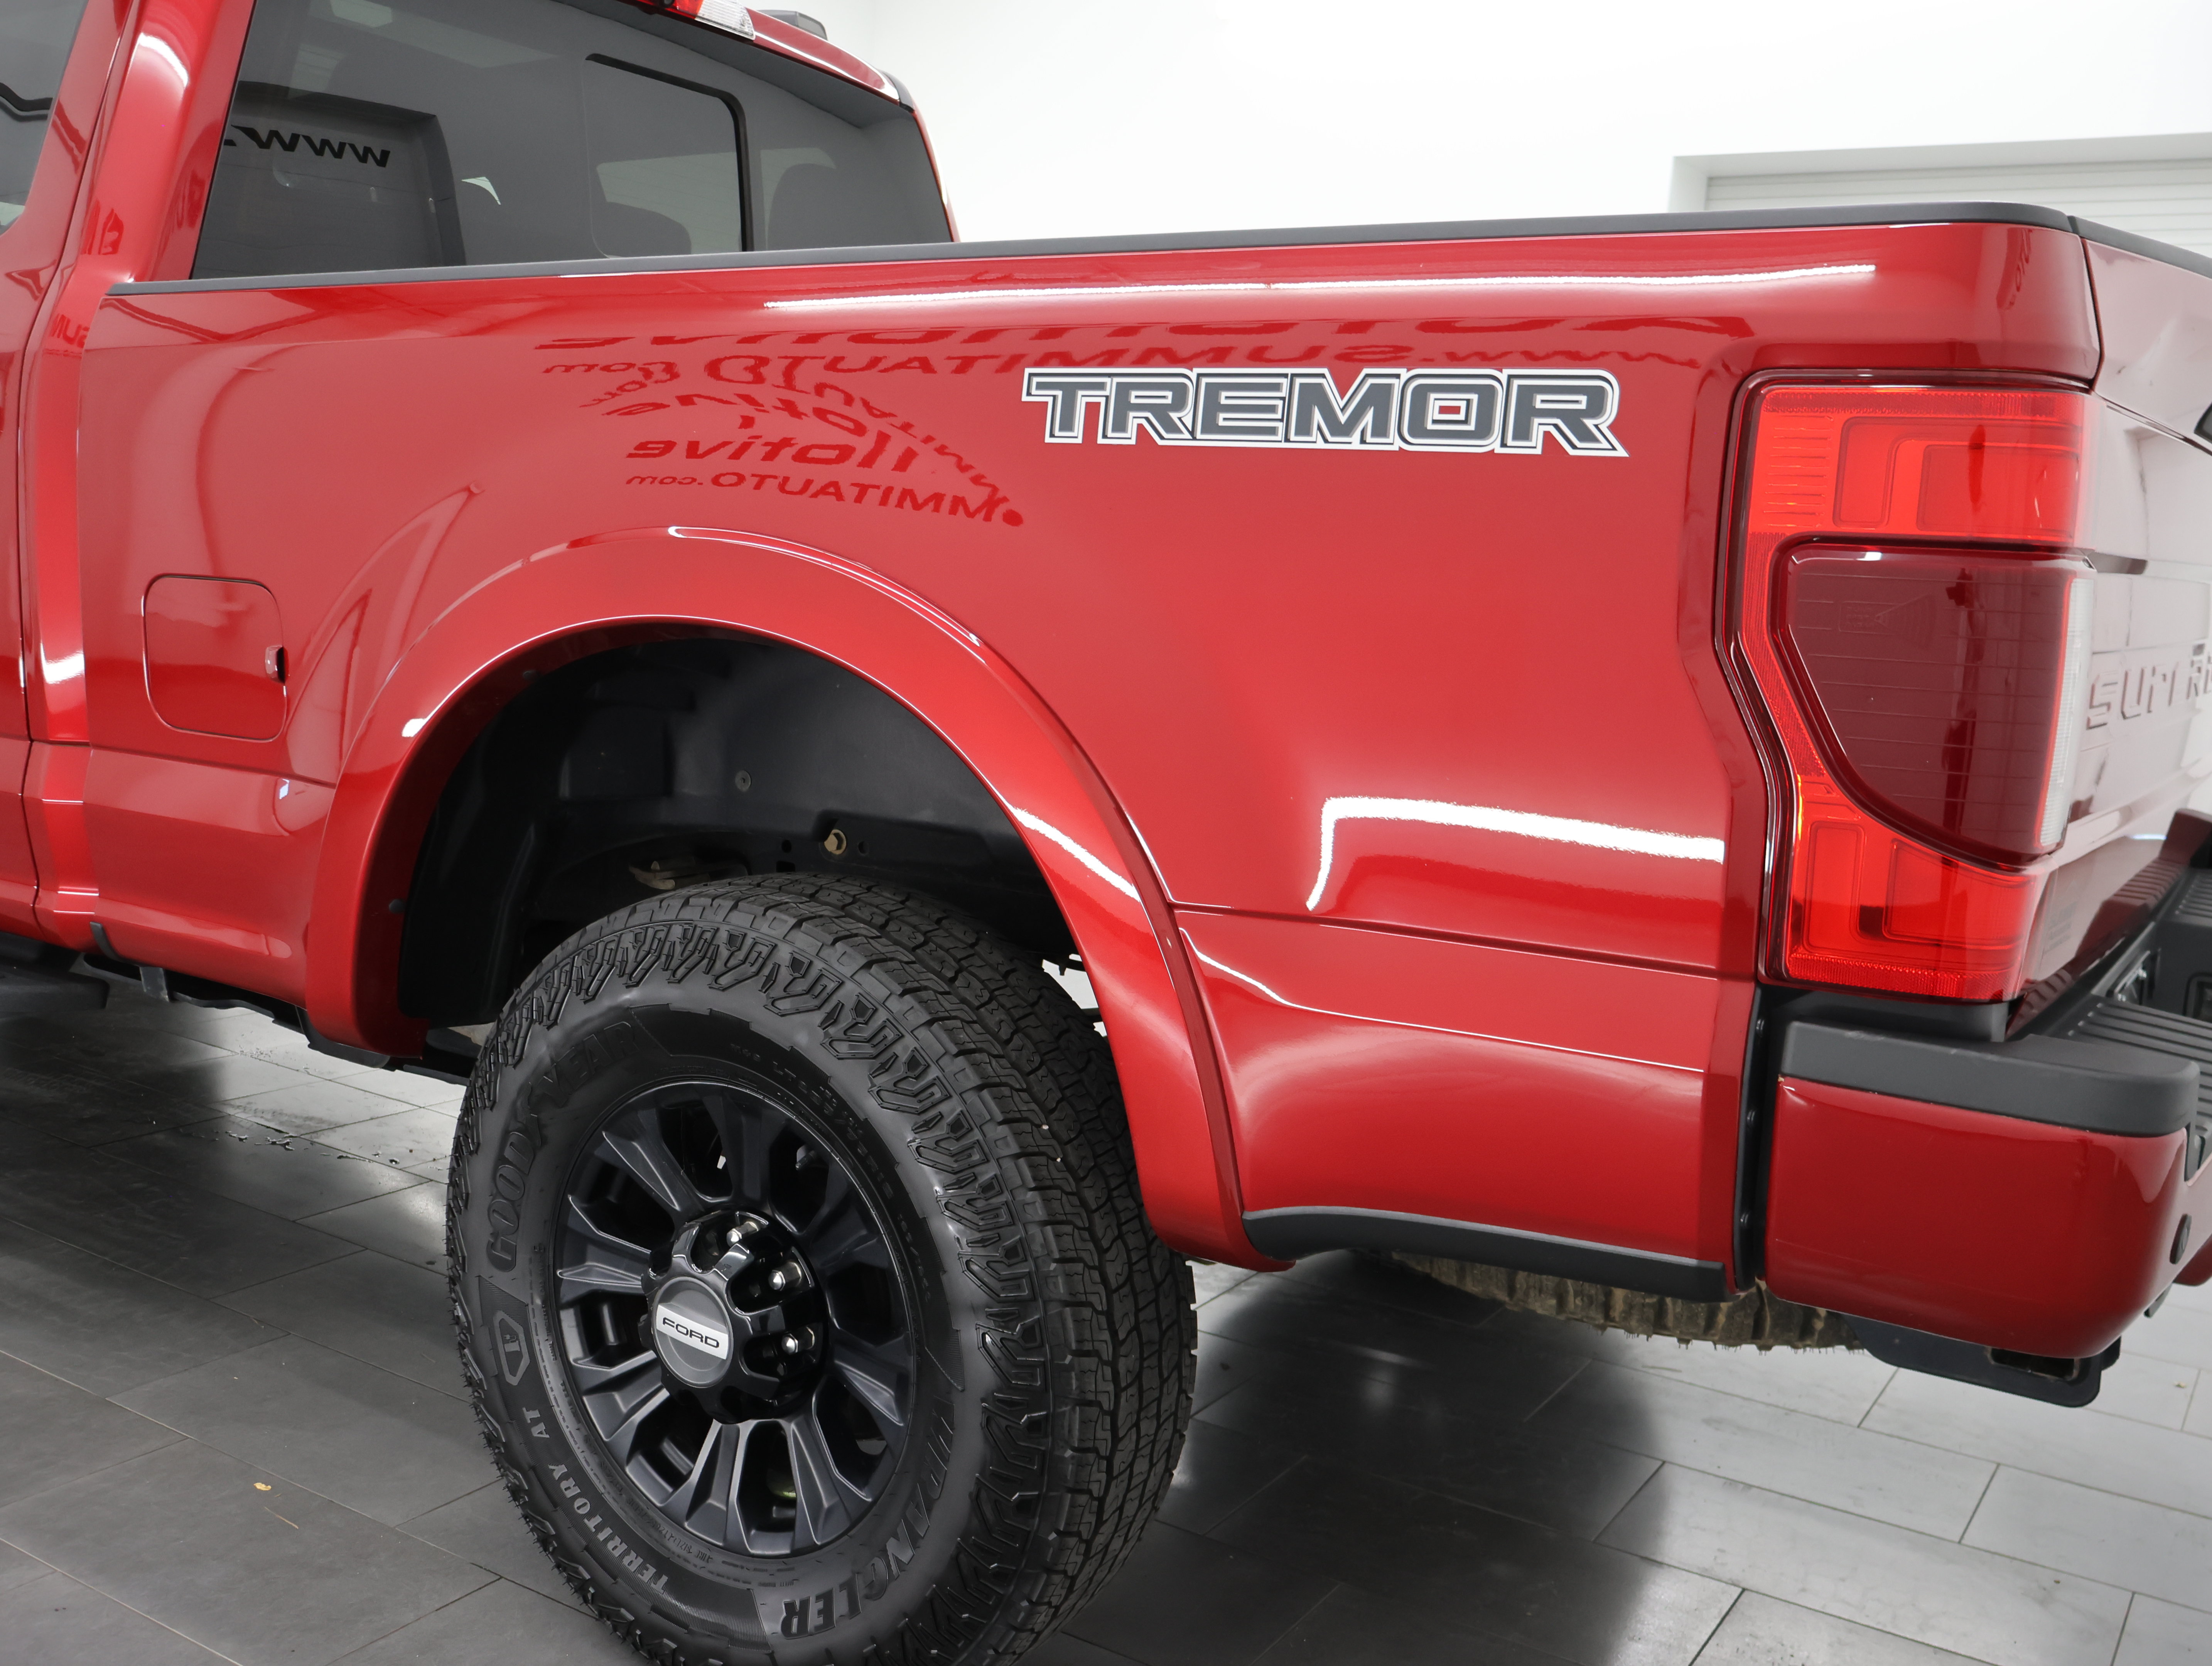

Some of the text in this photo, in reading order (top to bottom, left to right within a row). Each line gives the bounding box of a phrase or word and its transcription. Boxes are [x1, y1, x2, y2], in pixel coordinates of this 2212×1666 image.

[1021, 367, 1630, 457] TREMOR
[662, 1317, 720, 1348] FORD
[522, 1407, 550, 1439] AT
[548, 1464, 669, 1594] TERRITORY
[780, 1397, 955, 1640] WRANGLER
